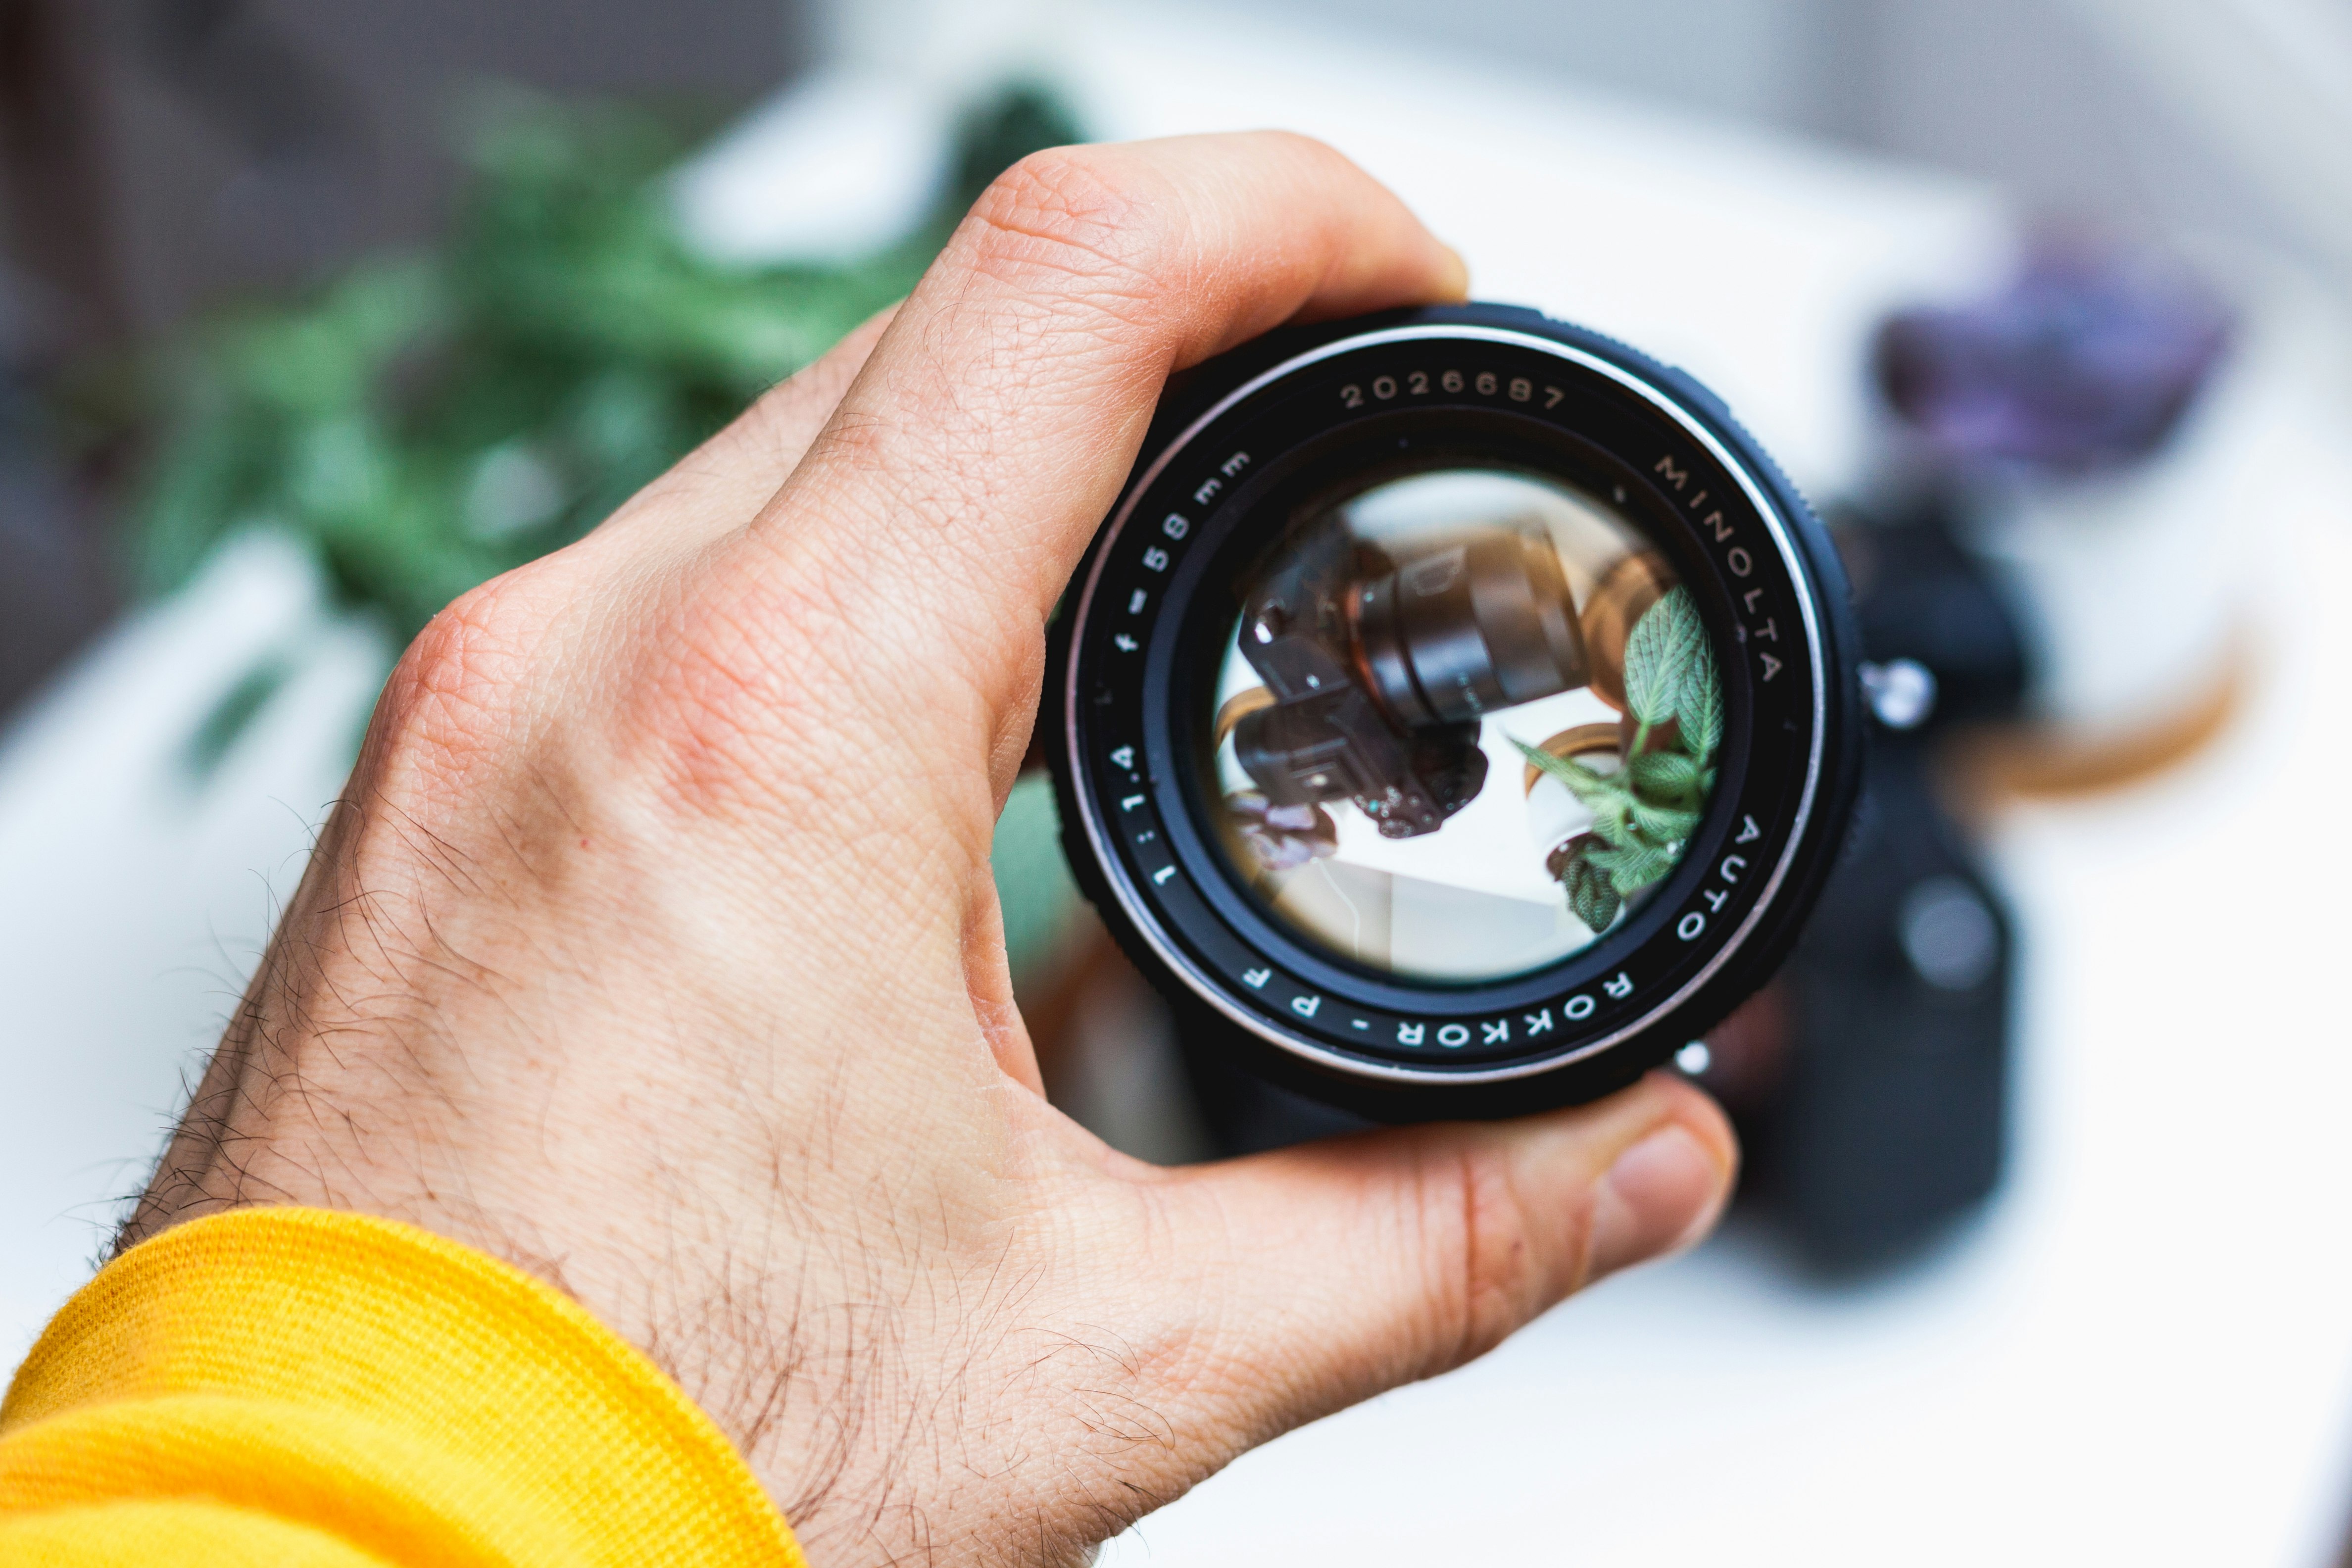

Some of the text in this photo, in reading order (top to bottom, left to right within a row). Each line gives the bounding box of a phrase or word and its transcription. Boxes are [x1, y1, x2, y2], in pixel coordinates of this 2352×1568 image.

[1340, 370, 1564, 409] 2026687
[1654, 455, 1783, 682] MINOLTA
[1677, 814, 1761, 941] AUTO
